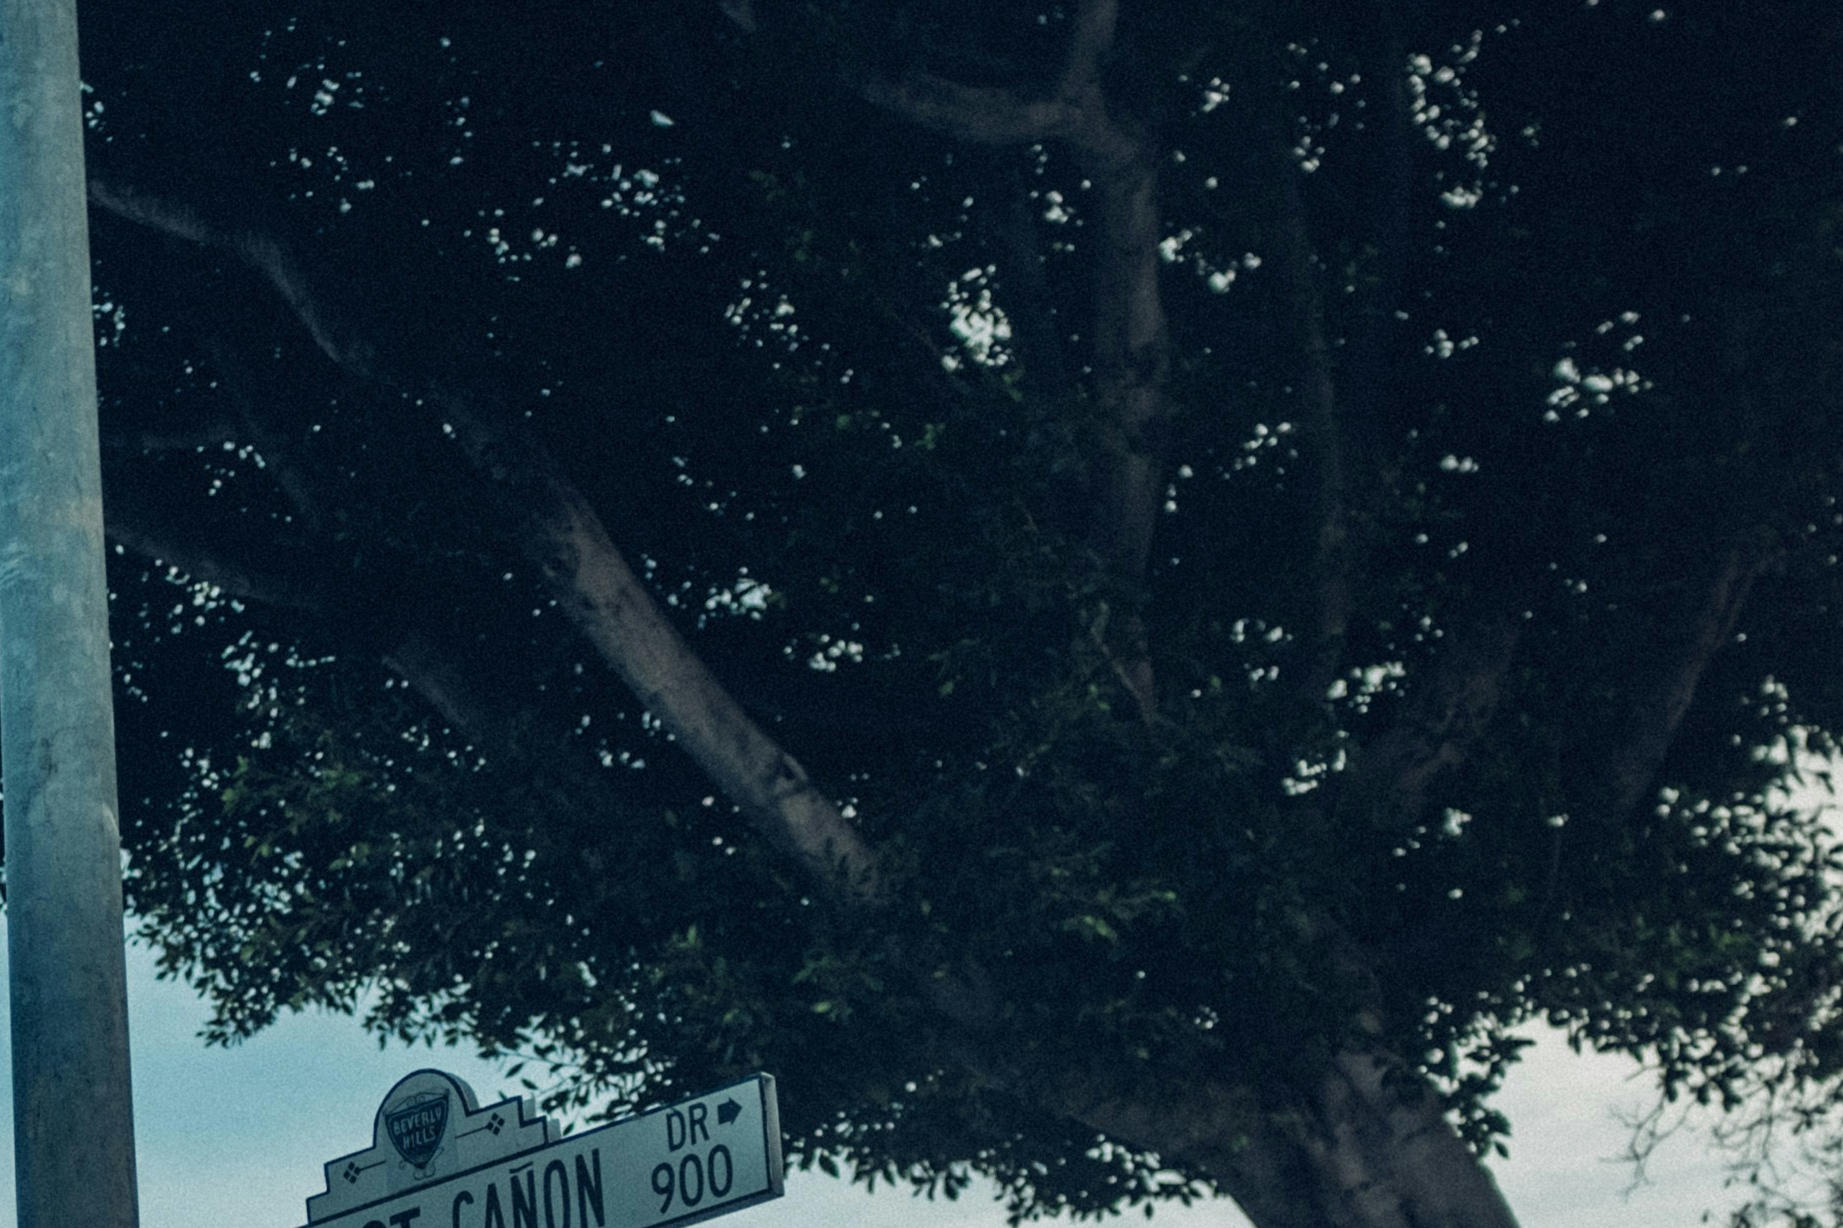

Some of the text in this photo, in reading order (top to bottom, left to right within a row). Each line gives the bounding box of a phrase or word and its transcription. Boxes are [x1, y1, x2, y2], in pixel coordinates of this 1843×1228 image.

[392, 1106, 443, 1136] BEVERLY
[402, 1124, 436, 1149] HILLS
[666, 1103, 710, 1152] DR
[651, 1146, 732, 1214] 900
